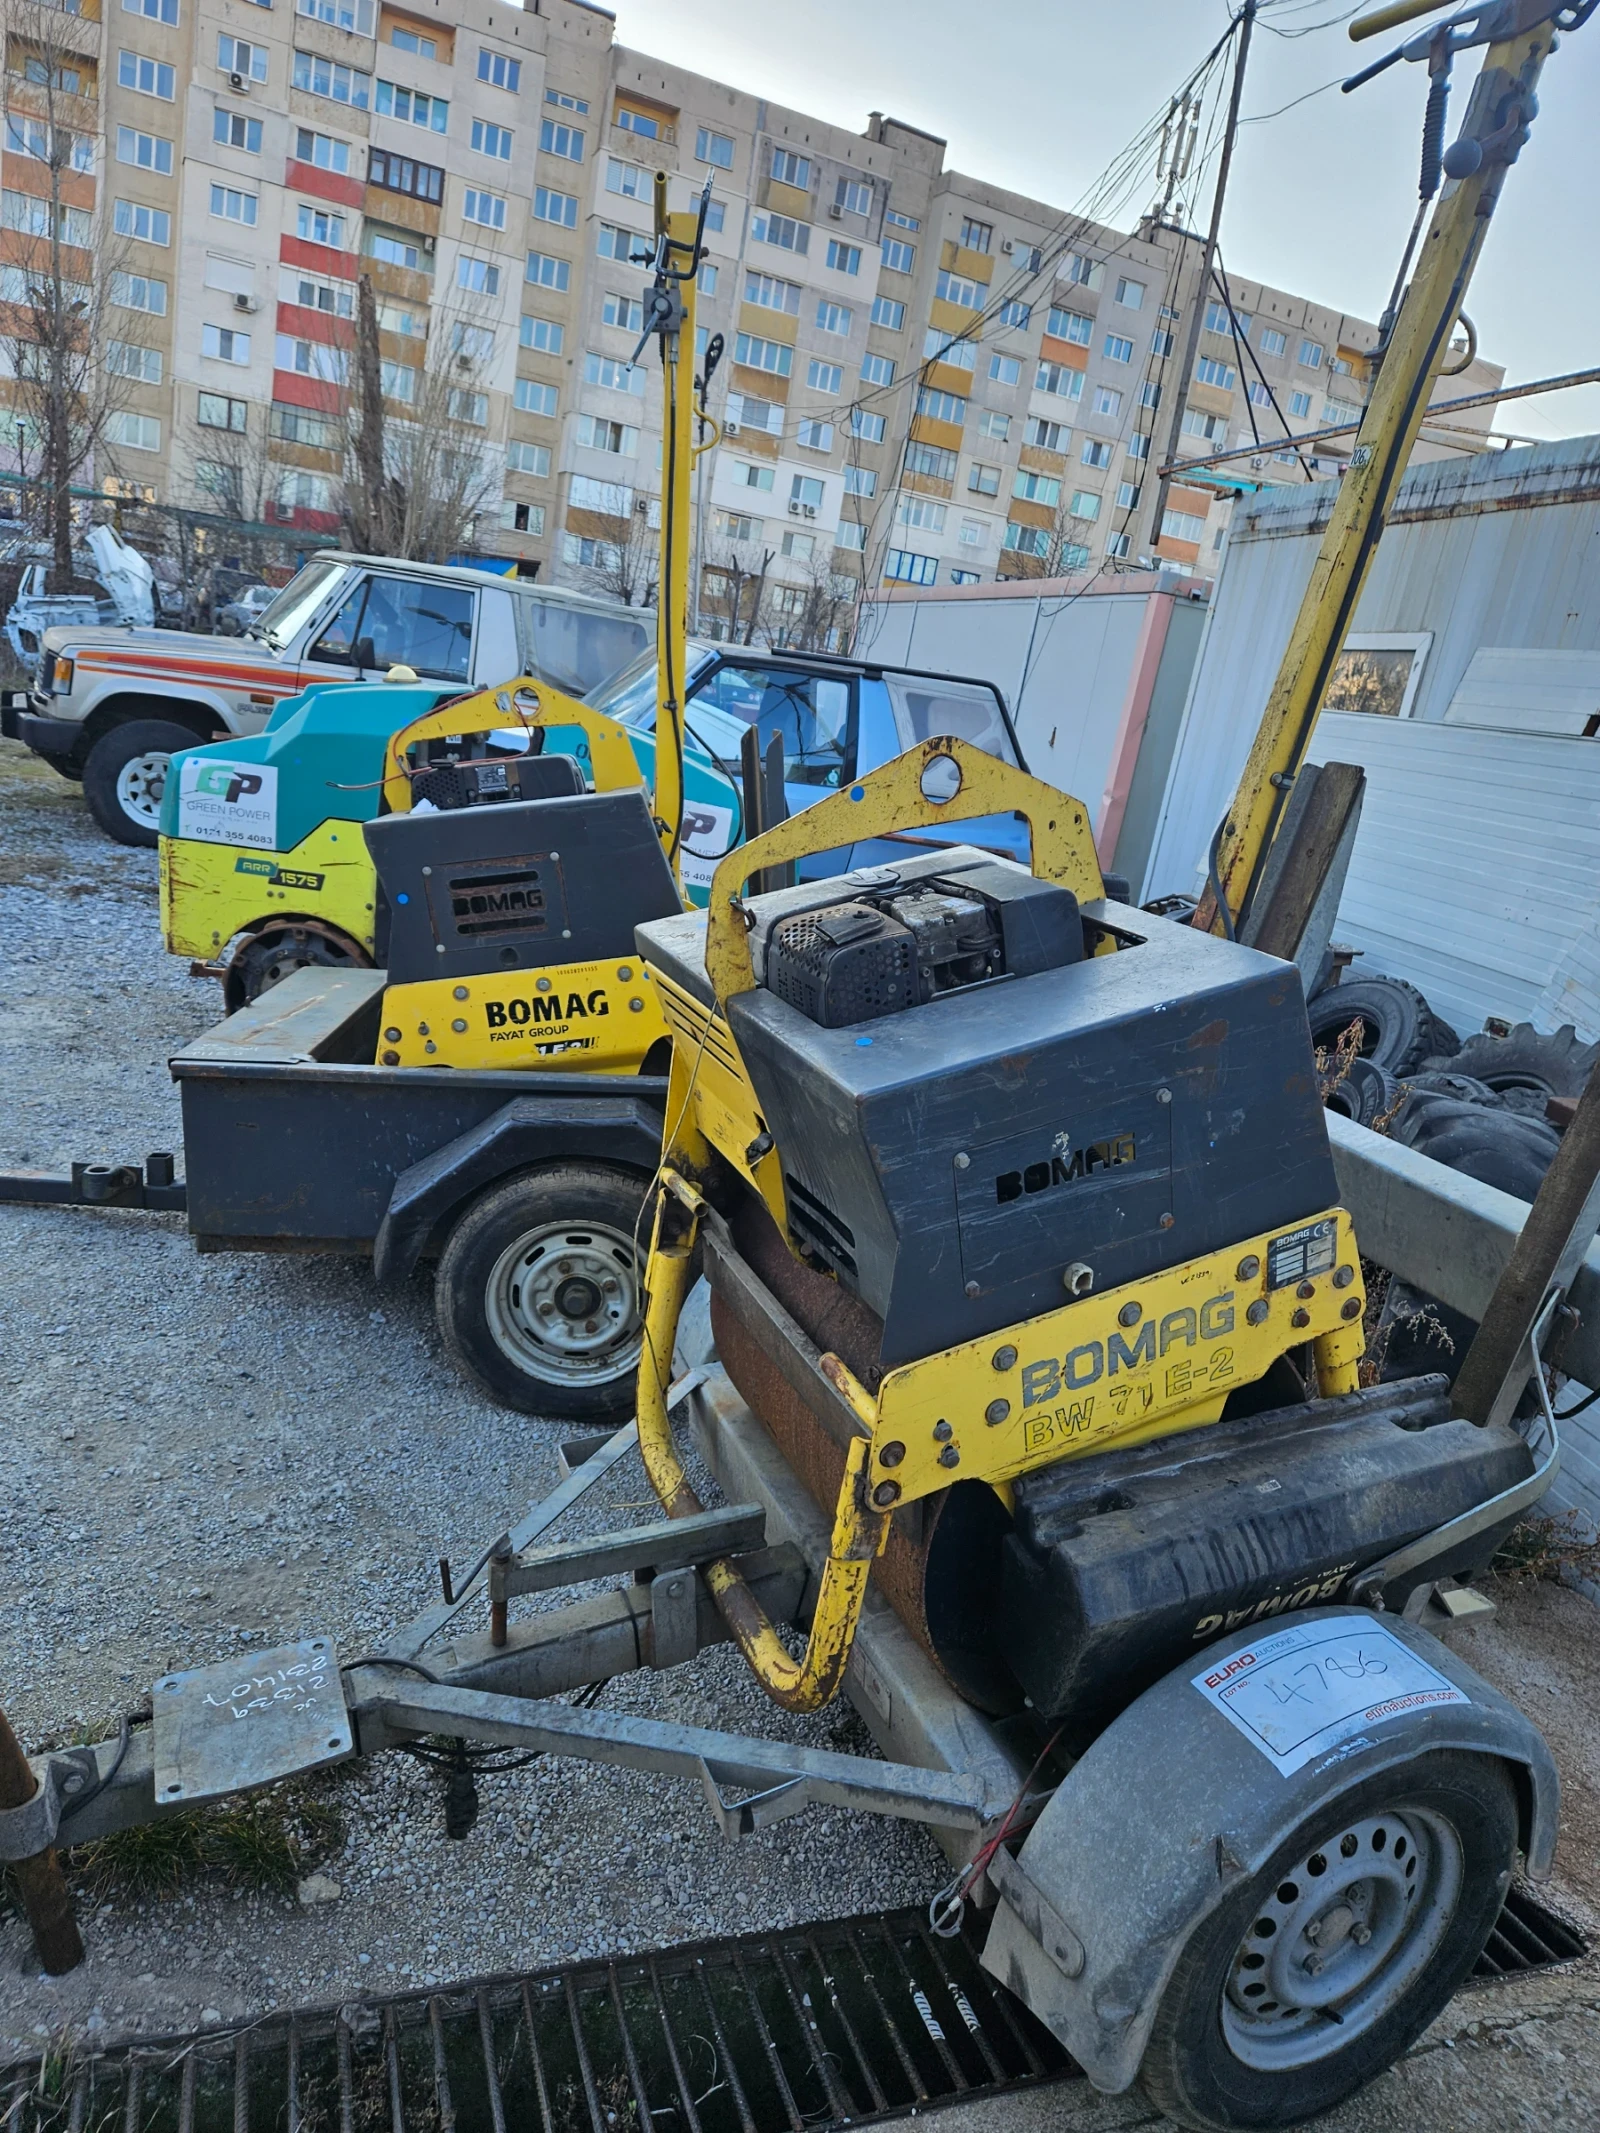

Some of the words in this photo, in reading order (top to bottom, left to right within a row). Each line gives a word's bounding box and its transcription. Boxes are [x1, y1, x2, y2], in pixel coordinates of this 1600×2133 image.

[187, 801, 226, 815] GREEN
[229, 804, 271, 821] POWER
[225, 831, 244, 841] 355
[247, 834, 273, 844] 4083
[681, 811, 717, 842] P
[242, 862, 271, 873] ARR
[280, 872, 318, 887] 1575
[452, 889, 543, 916] BOMAG
[485, 990, 609, 1028] BOMAG
[490, 1030, 525, 1042] FAYAT
[529, 1025, 569, 1038] GROUP
[996, 1132, 1136, 1205] BOMAG
[1277, 1229, 1310, 1248] BOMAG
[1021, 1291, 1235, 1409] BOMAG
[1024, 1397, 1095, 1453] BW
[1165, 1347, 1235, 1399] E-2
[1192, 1572, 1348, 1640] BOMAG
[1204, 1653, 1257, 1689] EURO
[1255, 1636, 1296, 1659] AUCTIONS
[1224, 1687, 1237, 1698] LOT
[1365, 1689, 1460, 1722] euroauctions.com
